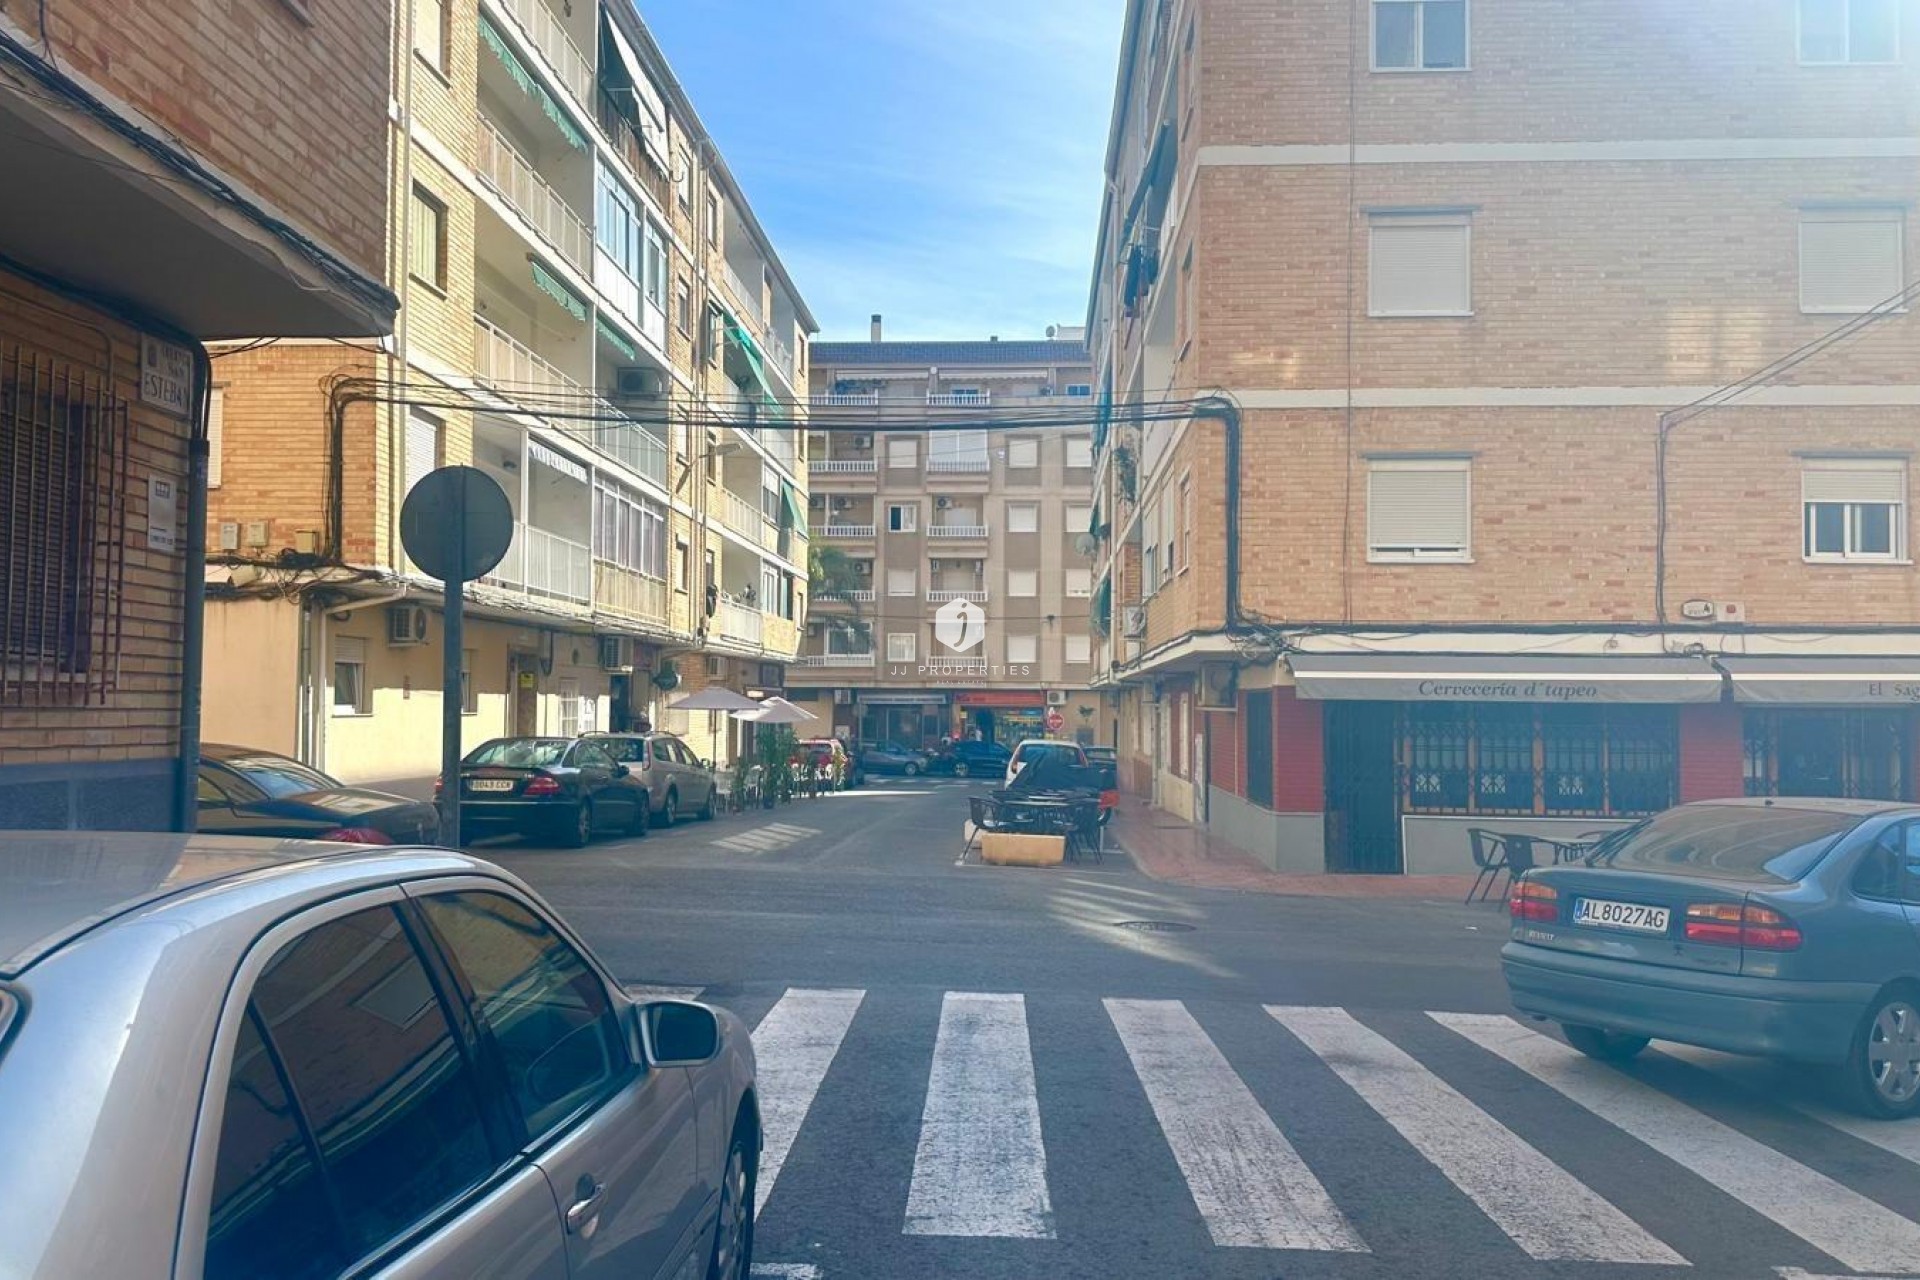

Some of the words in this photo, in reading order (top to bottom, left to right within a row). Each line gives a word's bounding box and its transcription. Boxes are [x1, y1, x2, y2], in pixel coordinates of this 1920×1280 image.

[1418, 680, 1518, 697] Cervecería
[1869, 682, 1882, 696] El
[1582, 901, 1665, 928] AL8027AG
